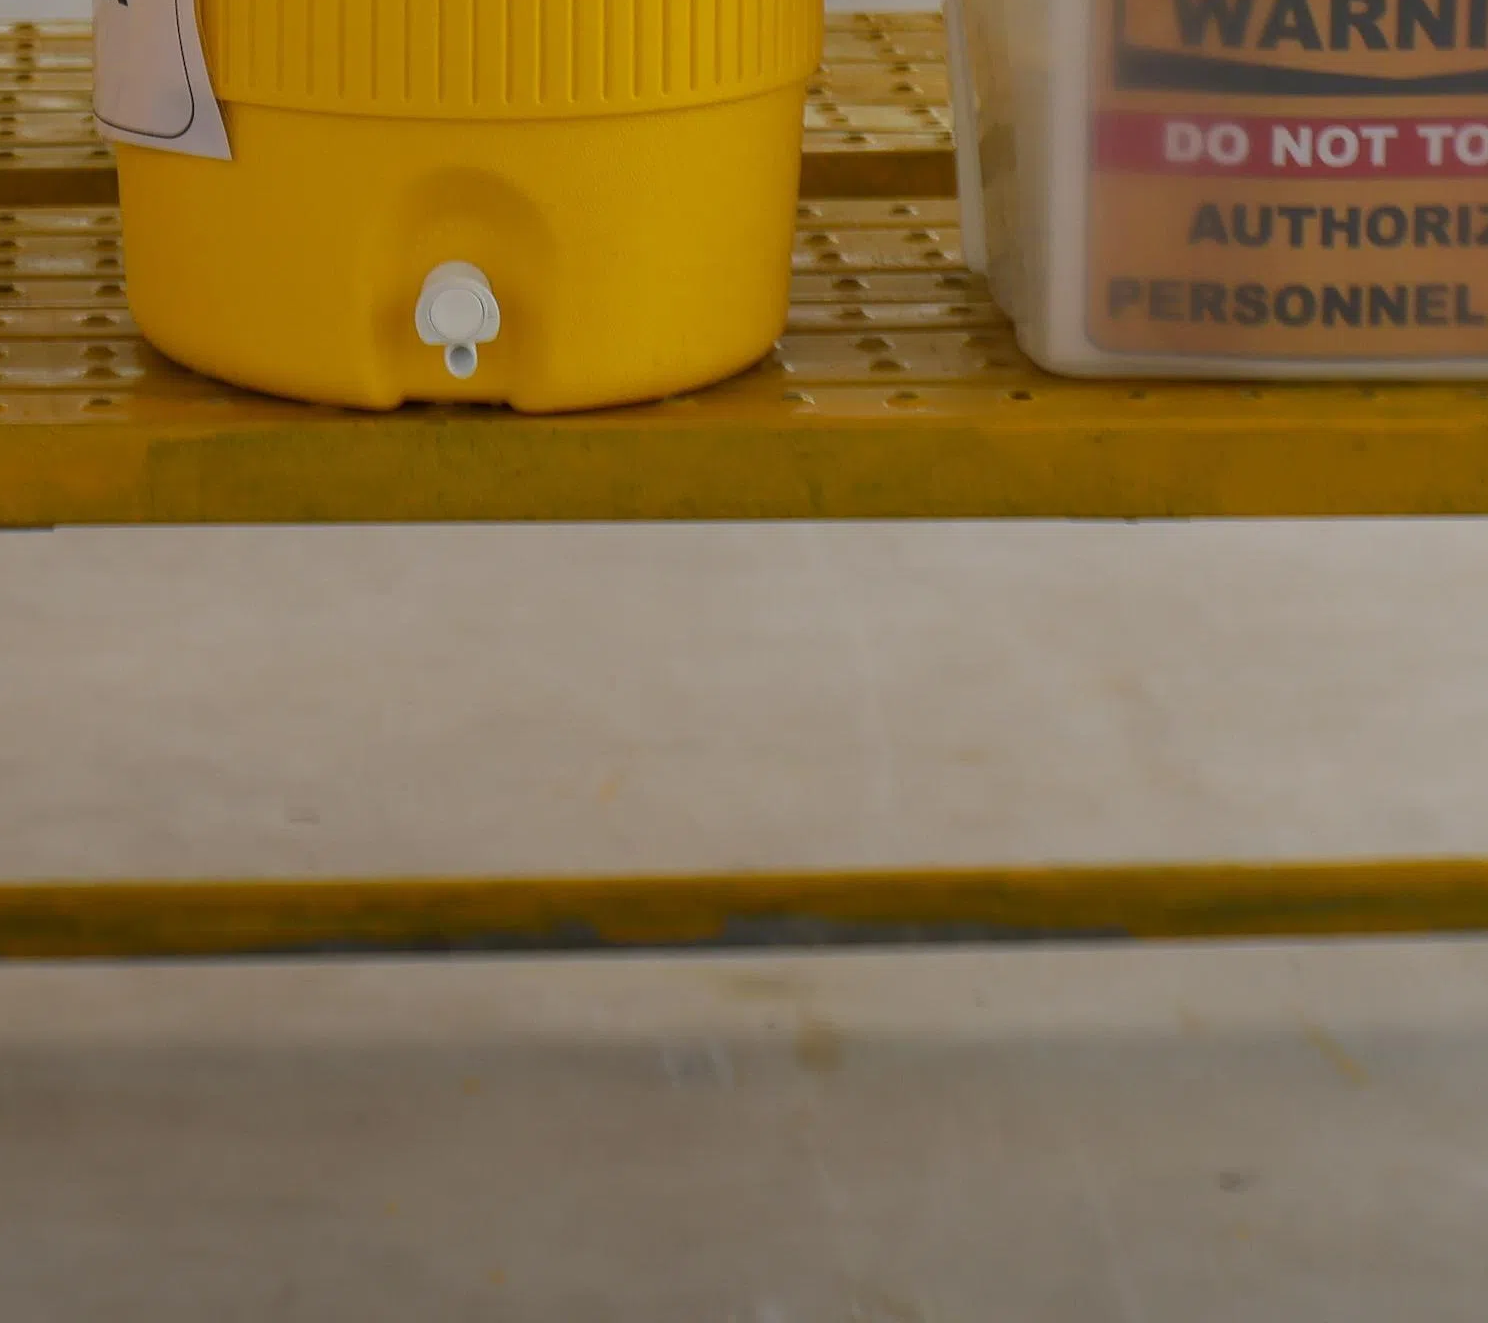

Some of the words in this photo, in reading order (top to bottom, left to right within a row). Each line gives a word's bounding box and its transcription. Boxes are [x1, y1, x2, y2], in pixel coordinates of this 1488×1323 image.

[1164, 123, 1250, 167] DO
[1270, 122, 1400, 168] NOT
[1108, 277, 1488, 329] PERSONNEL
